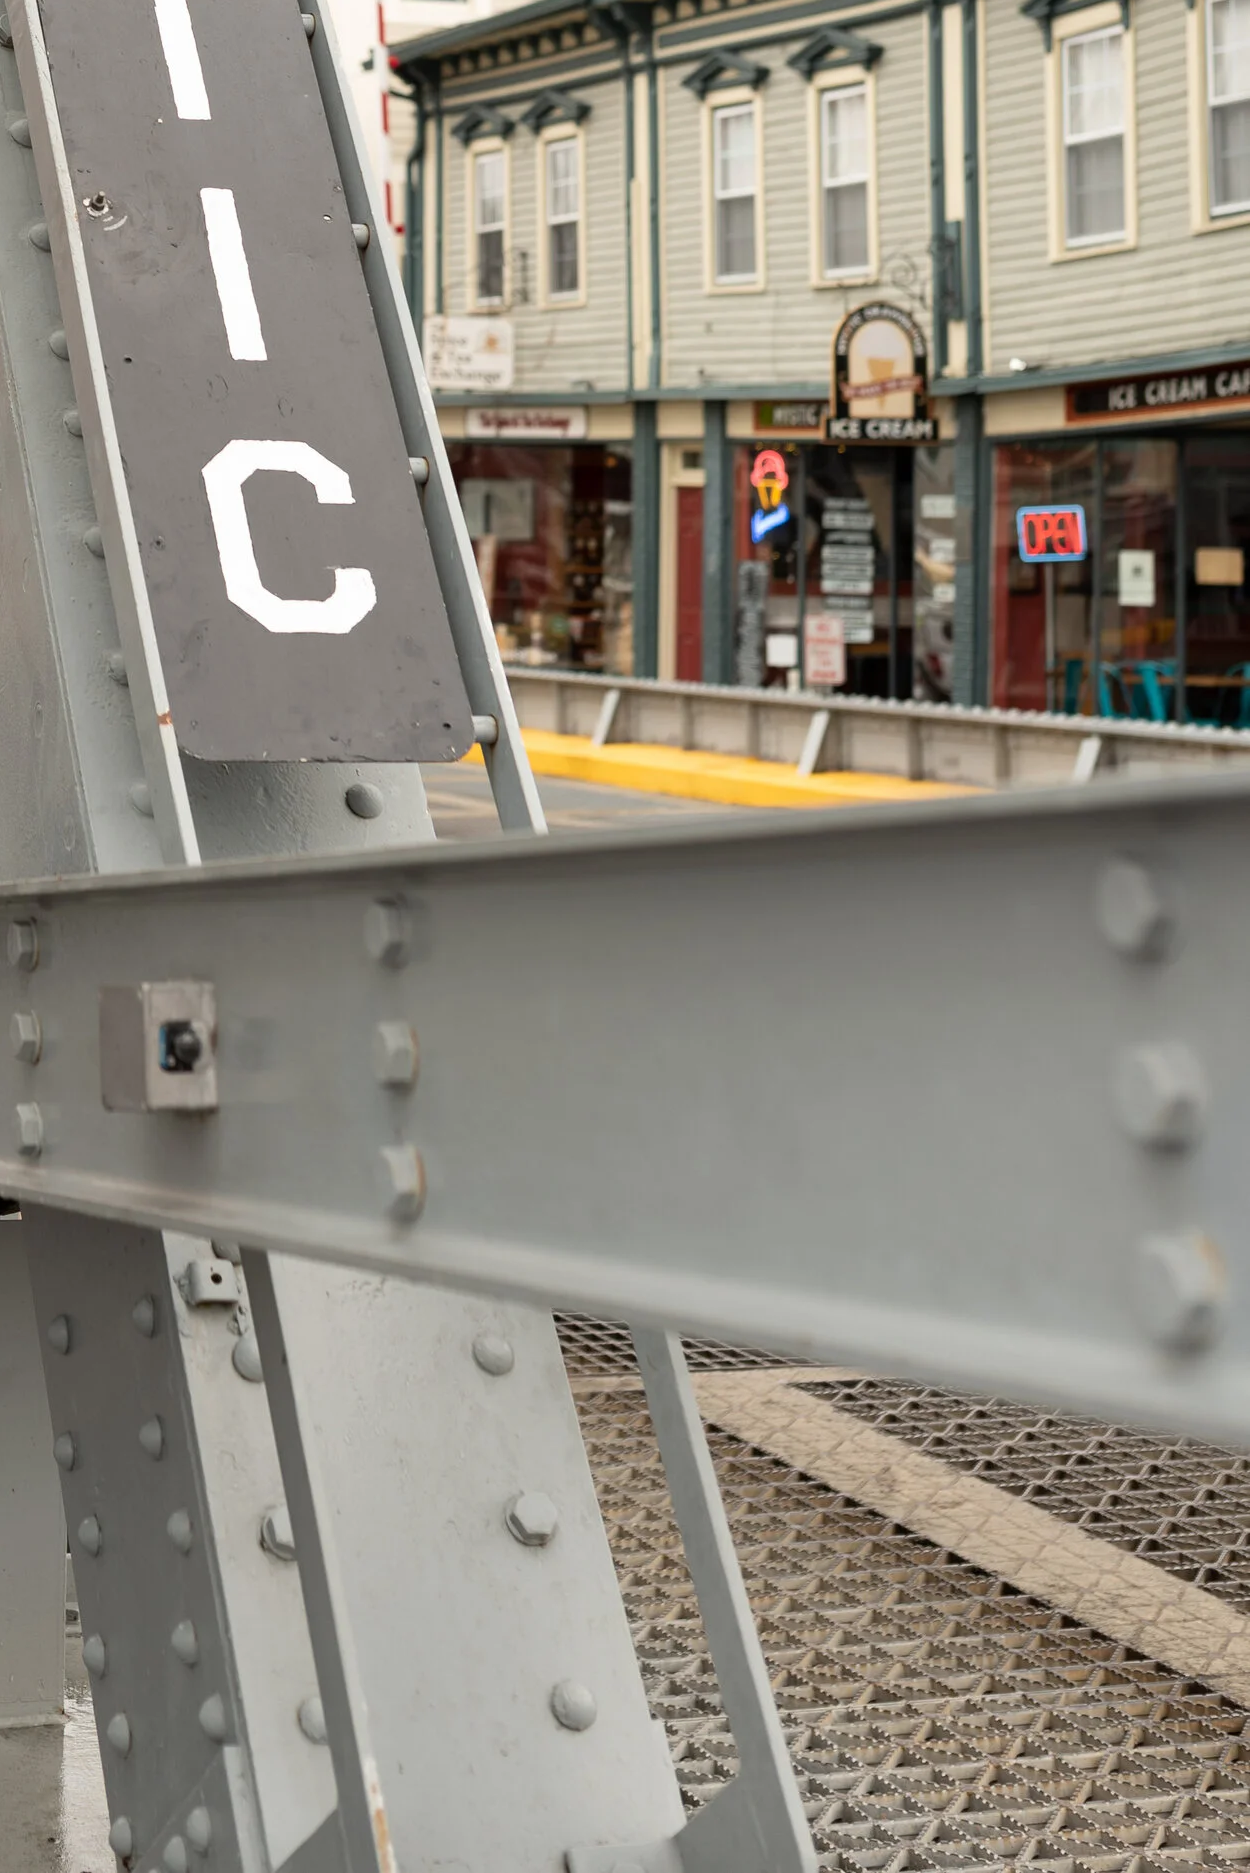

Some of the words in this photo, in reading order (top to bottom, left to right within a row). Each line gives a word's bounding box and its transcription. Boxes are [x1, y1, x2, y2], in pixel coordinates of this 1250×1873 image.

[1108, 383, 1137, 411] ICE
[1145, 375, 1207, 406] CREAM
[772, 403, 818, 427] MYSTIC
[829, 419, 861, 440] ICE
[865, 418, 933, 440] CREAM
[1023, 511, 1084, 557] OPEN
